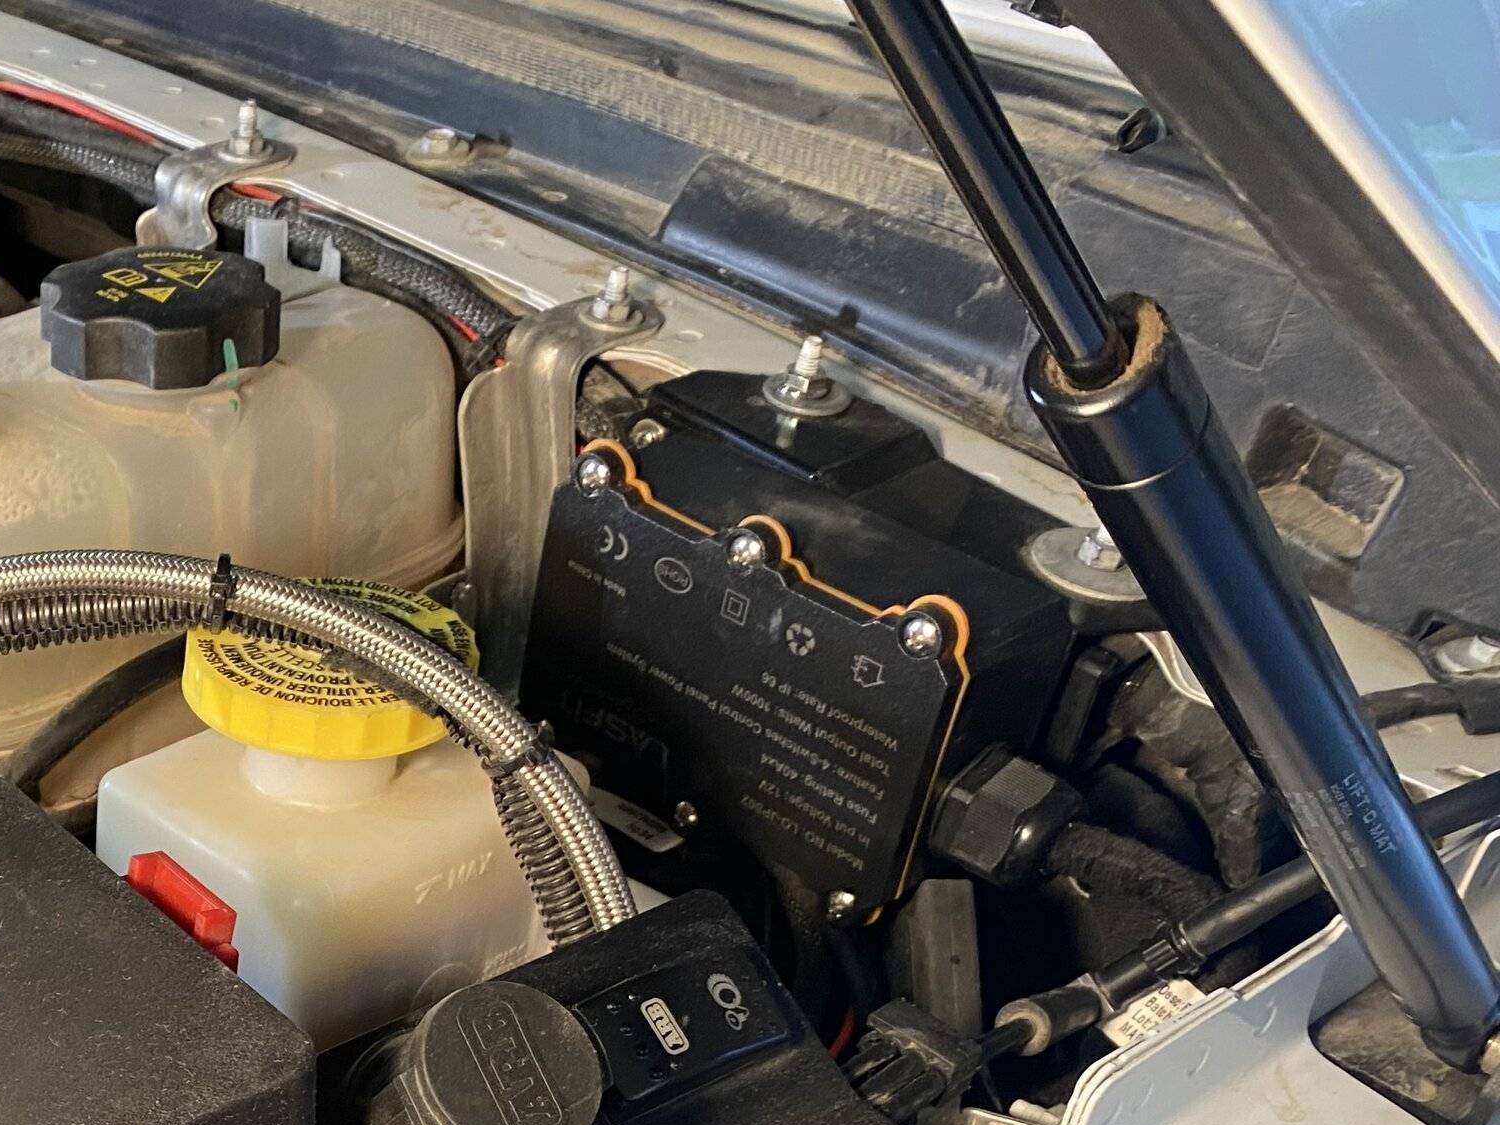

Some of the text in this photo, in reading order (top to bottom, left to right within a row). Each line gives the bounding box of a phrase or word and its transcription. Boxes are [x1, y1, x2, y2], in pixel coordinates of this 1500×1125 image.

[365, 580, 407, 596] FLUID
[367, 590, 420, 614] BEFORE
[198, 638, 249, 687] REMPLISSAGE
[220, 643, 357, 697] UTILISER UNIQUEMENT
[258, 656, 350, 686] PROVENANT
[251, 684, 271, 696] DE
[276, 691, 352, 707] BOUCHON
[357, 696, 375, 707] LE
[731, 682, 771, 712] 1000W
[605, 639, 884, 801] Feature: 4-Switches Control Panel Power System
[828, 703, 898, 752] Waterproof
[814, 724, 857, 758] Output
[858, 749, 891, 777] Total
[799, 771, 844, 806] Rating:
[845, 798, 877, 824] Fuse
[826, 840, 864, 871] Model
[645, 1002, 686, 1051] ARB
